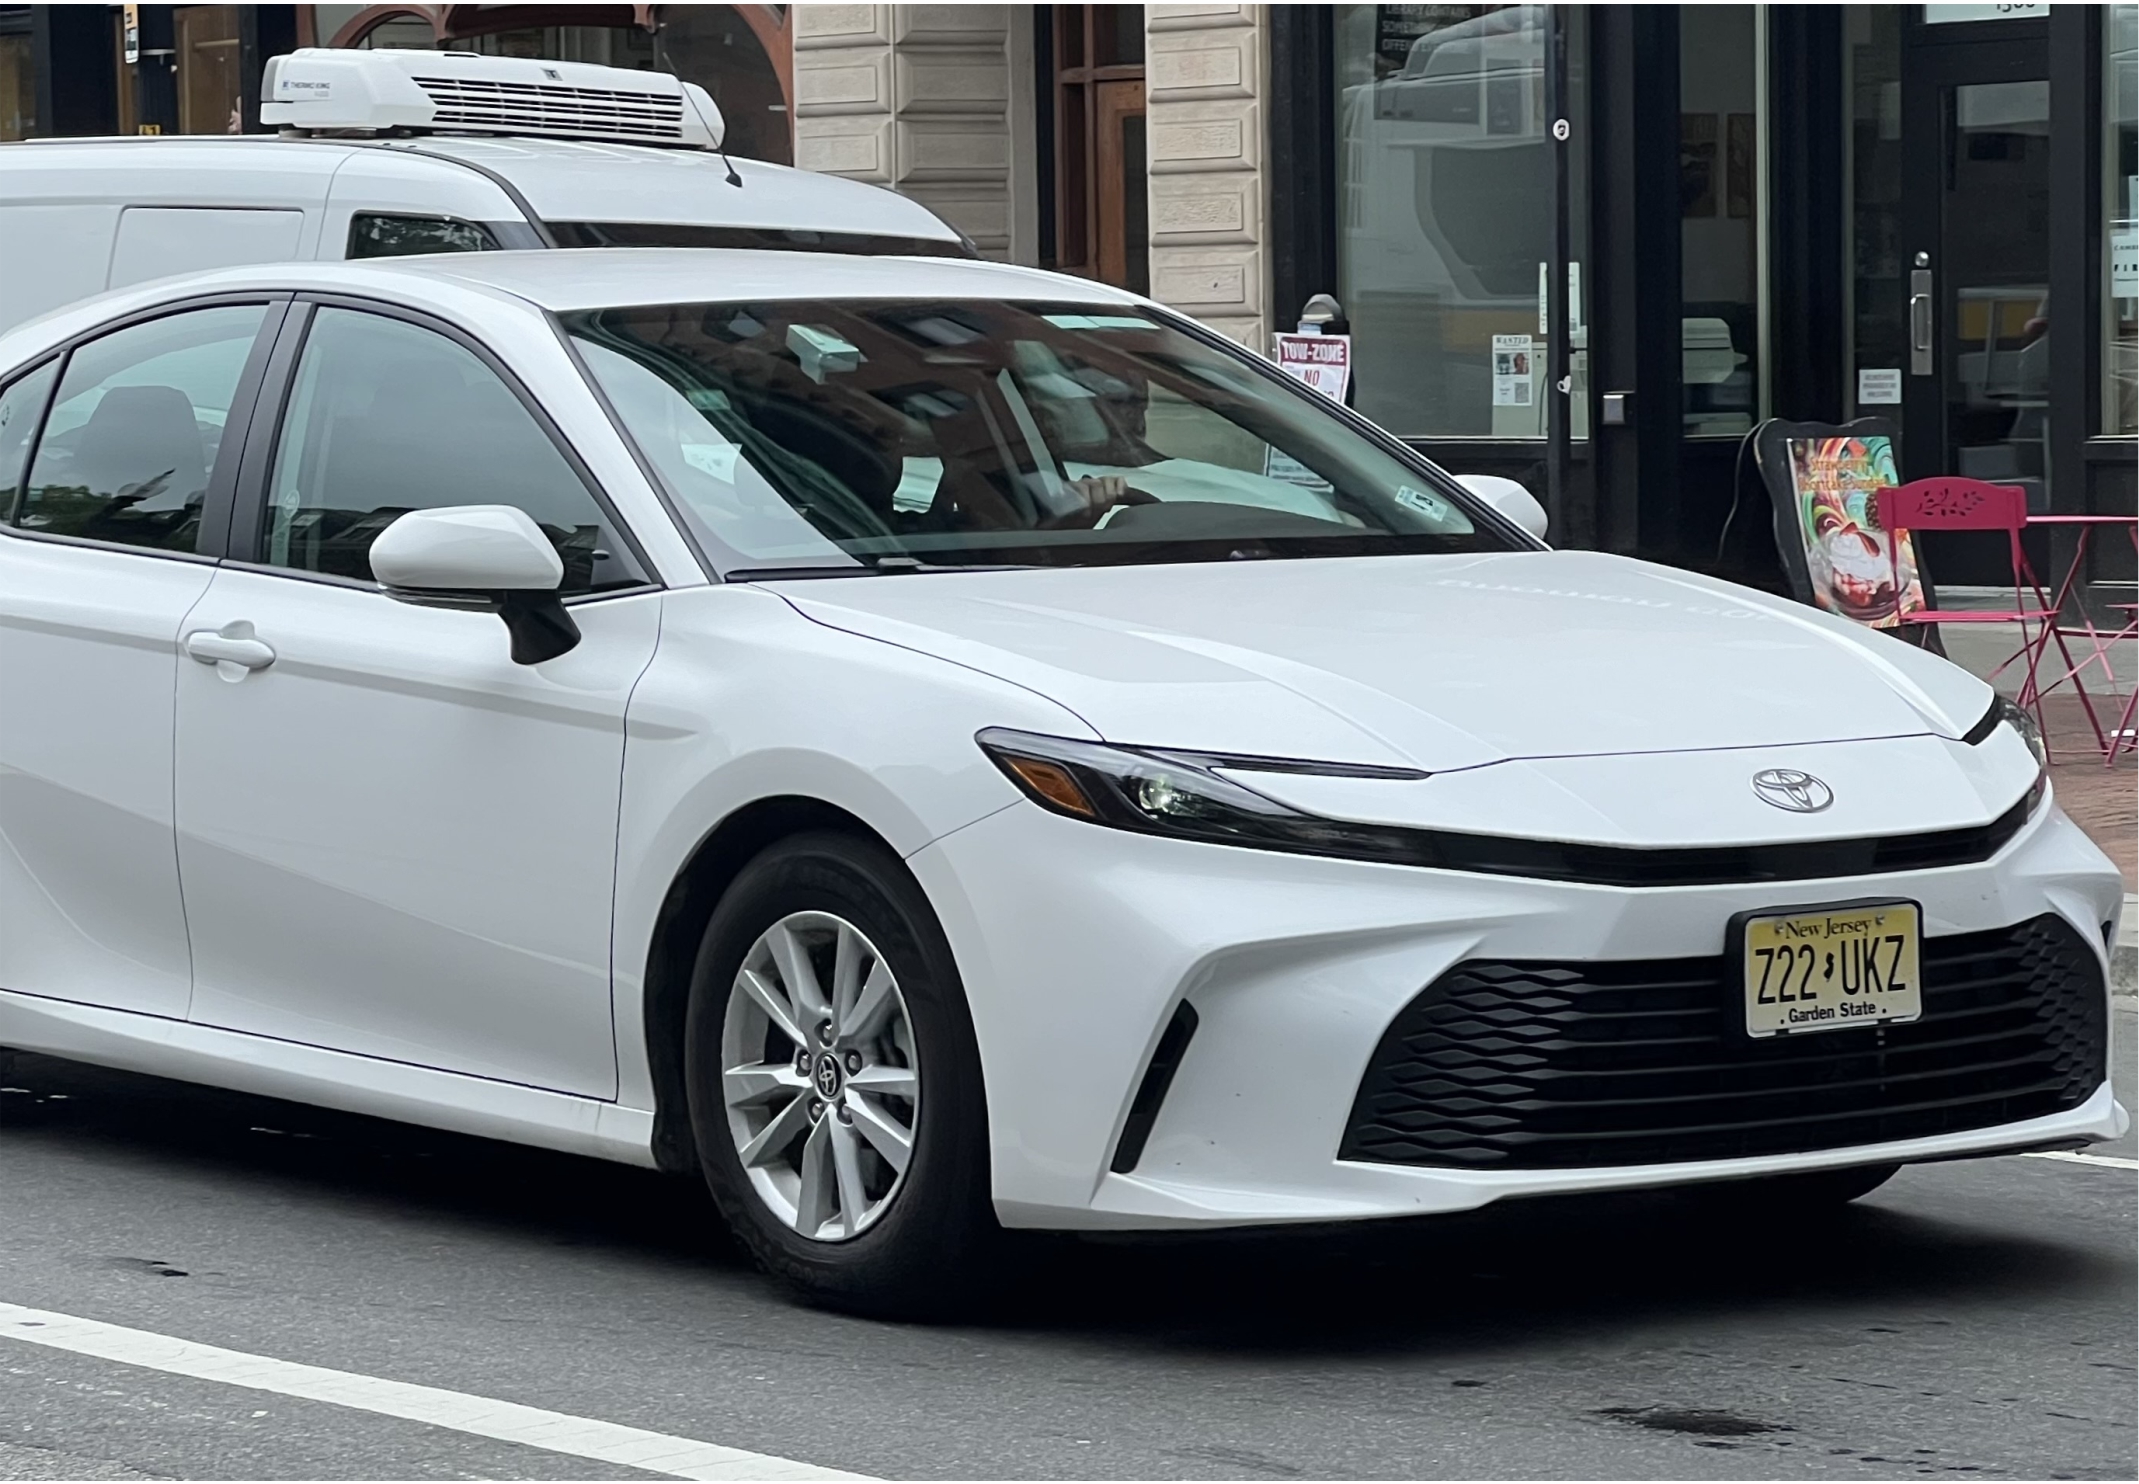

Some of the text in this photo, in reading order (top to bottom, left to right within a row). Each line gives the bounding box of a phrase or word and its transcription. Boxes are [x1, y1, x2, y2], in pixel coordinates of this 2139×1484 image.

[1281, 341, 1345, 362] TOW-ZONE
[1304, 369, 1320, 387] NO
[1785, 917, 1873, 940] New Jersey
[1755, 934, 1906, 1005] Z22 UKZ
[1788, 1001, 1877, 1024] Garden State
